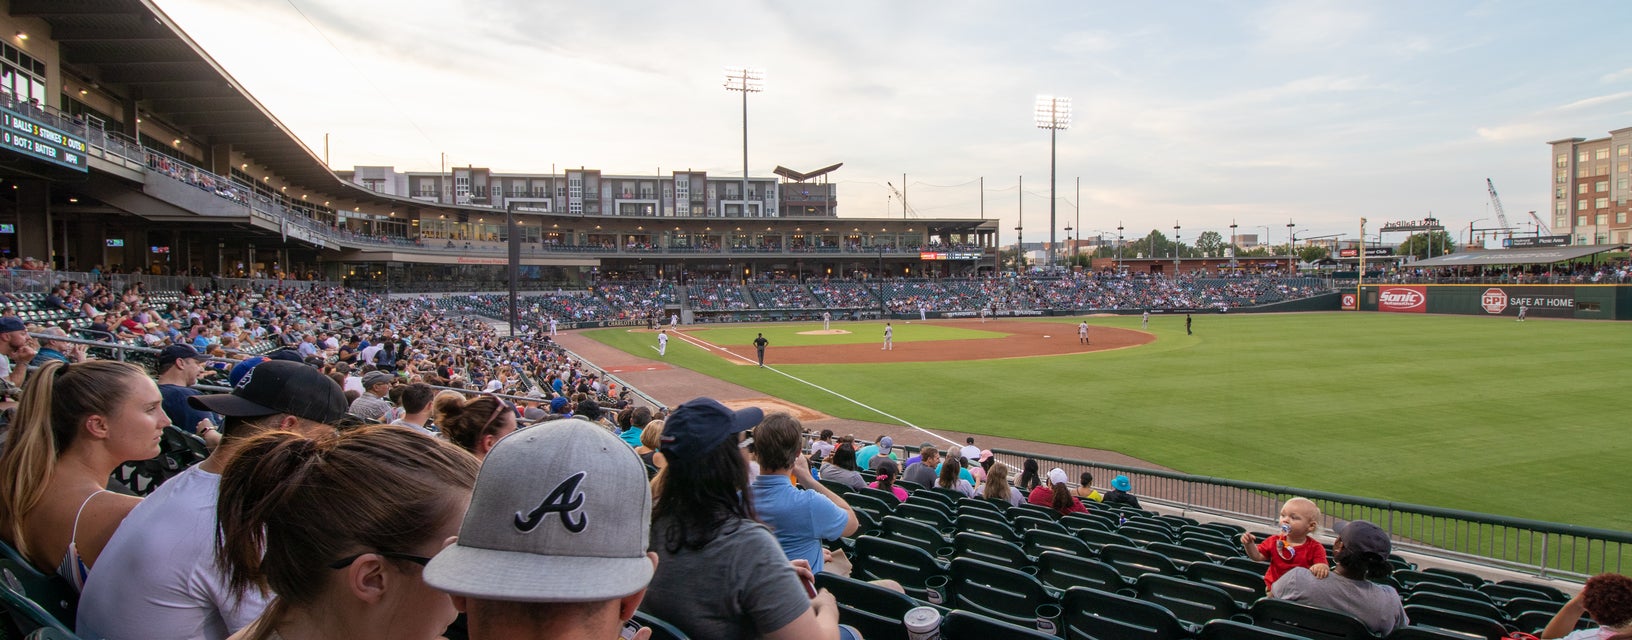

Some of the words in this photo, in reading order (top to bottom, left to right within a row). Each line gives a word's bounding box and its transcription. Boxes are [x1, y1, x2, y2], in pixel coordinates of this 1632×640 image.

[5, 114, 10, 125] 1
[4, 132, 10, 143] 0
[13, 118, 32, 133] BALLS
[33, 125, 39, 135] 3
[39, 128, 62, 143] STRIKES
[62, 137, 67, 146] 2
[67, 139, 81, 150] OUTS
[13, 136, 27, 148] BOT
[28, 140, 33, 150] 2
[35, 142, 56, 157] BATTER
[1379, 291, 1418, 302] Sonic
[1483, 296, 1505, 305] CPI
[1510, 297, 1532, 306] SAFE
[1533, 298, 1544, 306] AT
[1546, 298, 1574, 307] HOME
[607, 319, 636, 327] CHARLOTTE
[514, 471, 588, 534] A
